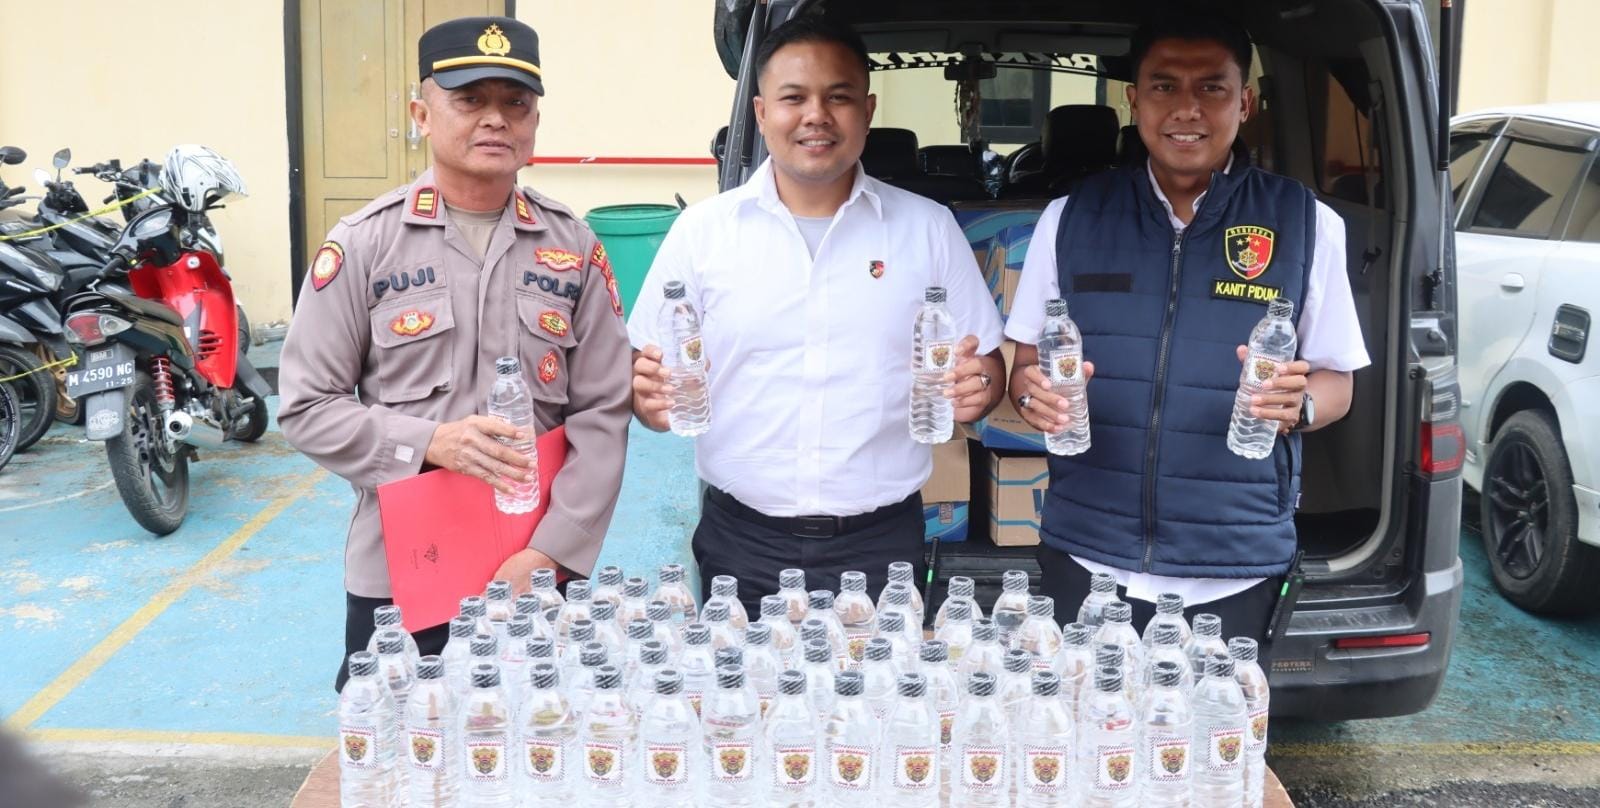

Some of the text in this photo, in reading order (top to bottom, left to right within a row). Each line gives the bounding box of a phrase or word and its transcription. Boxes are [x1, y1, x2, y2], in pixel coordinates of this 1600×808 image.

[373, 266, 436, 299] PUJI
[1215, 281, 1279, 302] KANIT PIDUM
[68, 362, 132, 387] M 4590 NG
